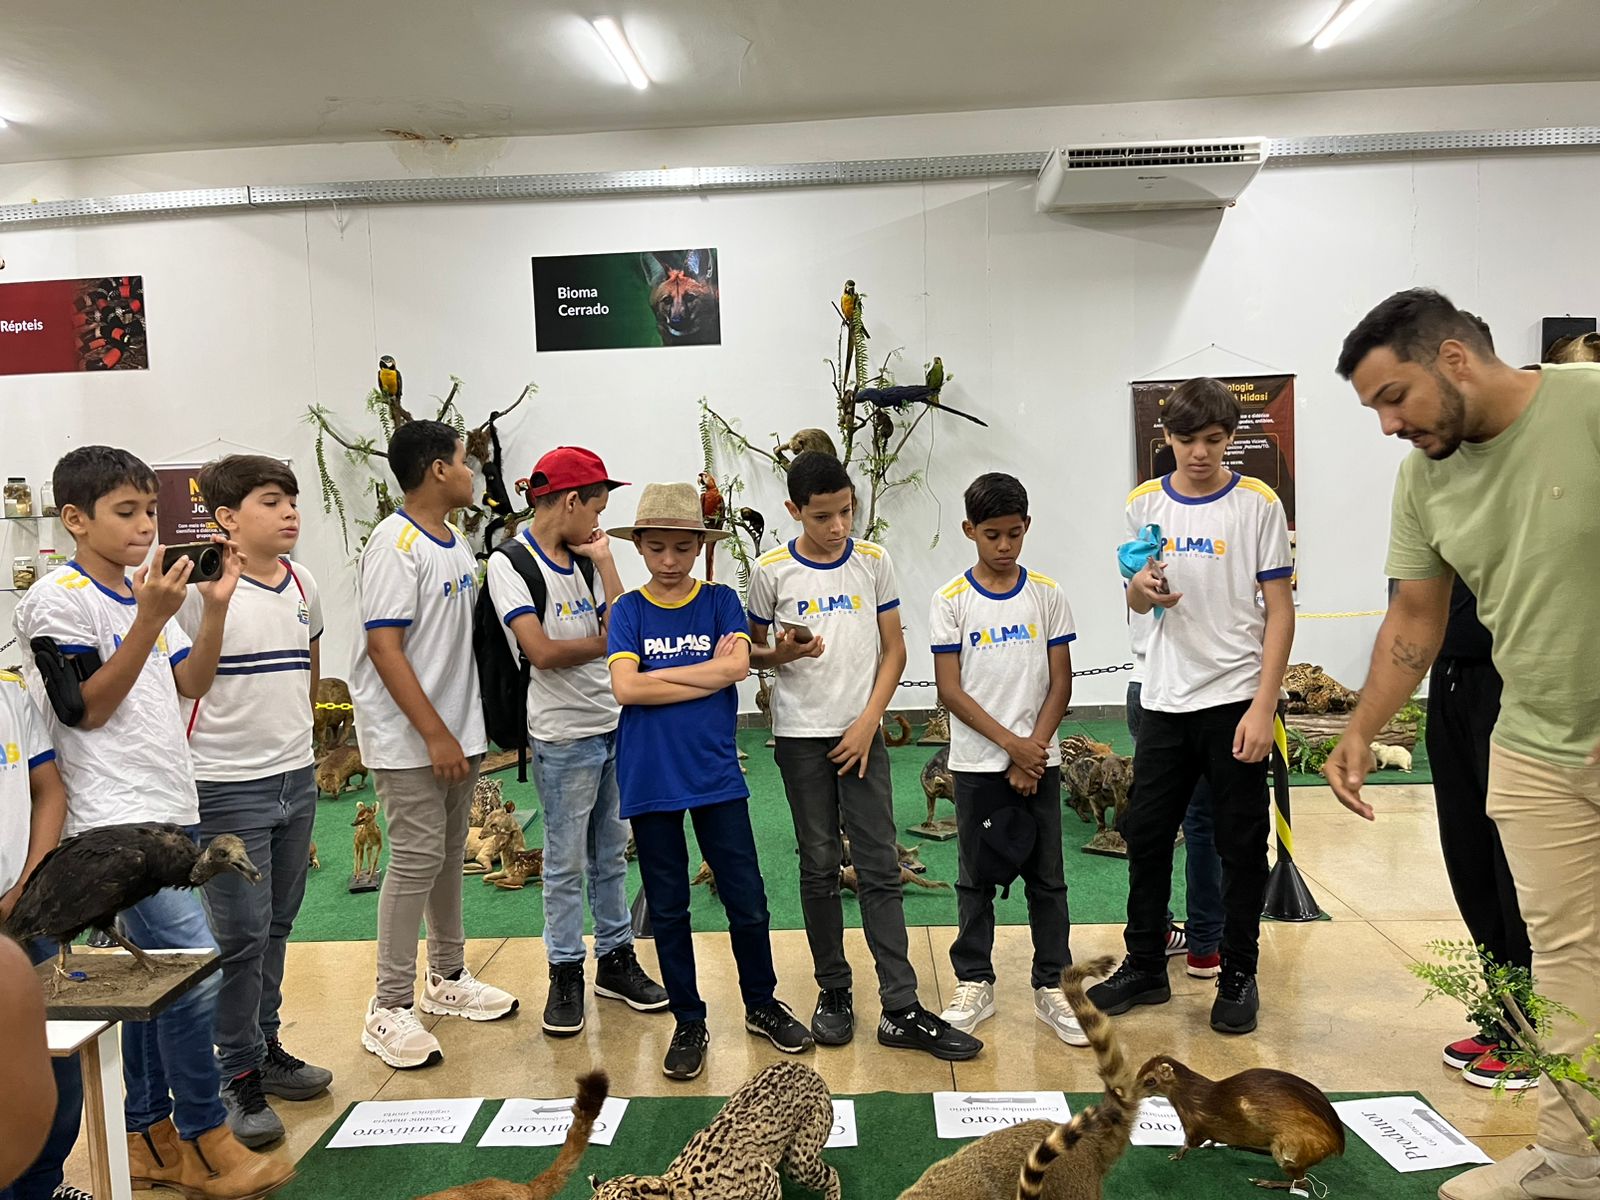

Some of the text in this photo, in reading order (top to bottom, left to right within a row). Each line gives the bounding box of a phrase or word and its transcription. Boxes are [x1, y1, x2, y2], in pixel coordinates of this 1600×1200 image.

[557, 286, 598, 299] Bioma
[558, 302, 610, 316] Cerrado
[0, 318, 44, 333] Répteis
[1240, 392, 1268, 402] Hidasi
[1160, 537, 1226, 555] PALMAS
[797, 594, 861, 616] PALMAS
[969, 623, 1038, 647] PALMAS
[644, 634, 711, 655] PALMAS
[649, 650, 708, 660] PREFEITURA
[352, 1123, 457, 1137] Detritívoro
[1360, 1111, 1428, 1160] Produtor
